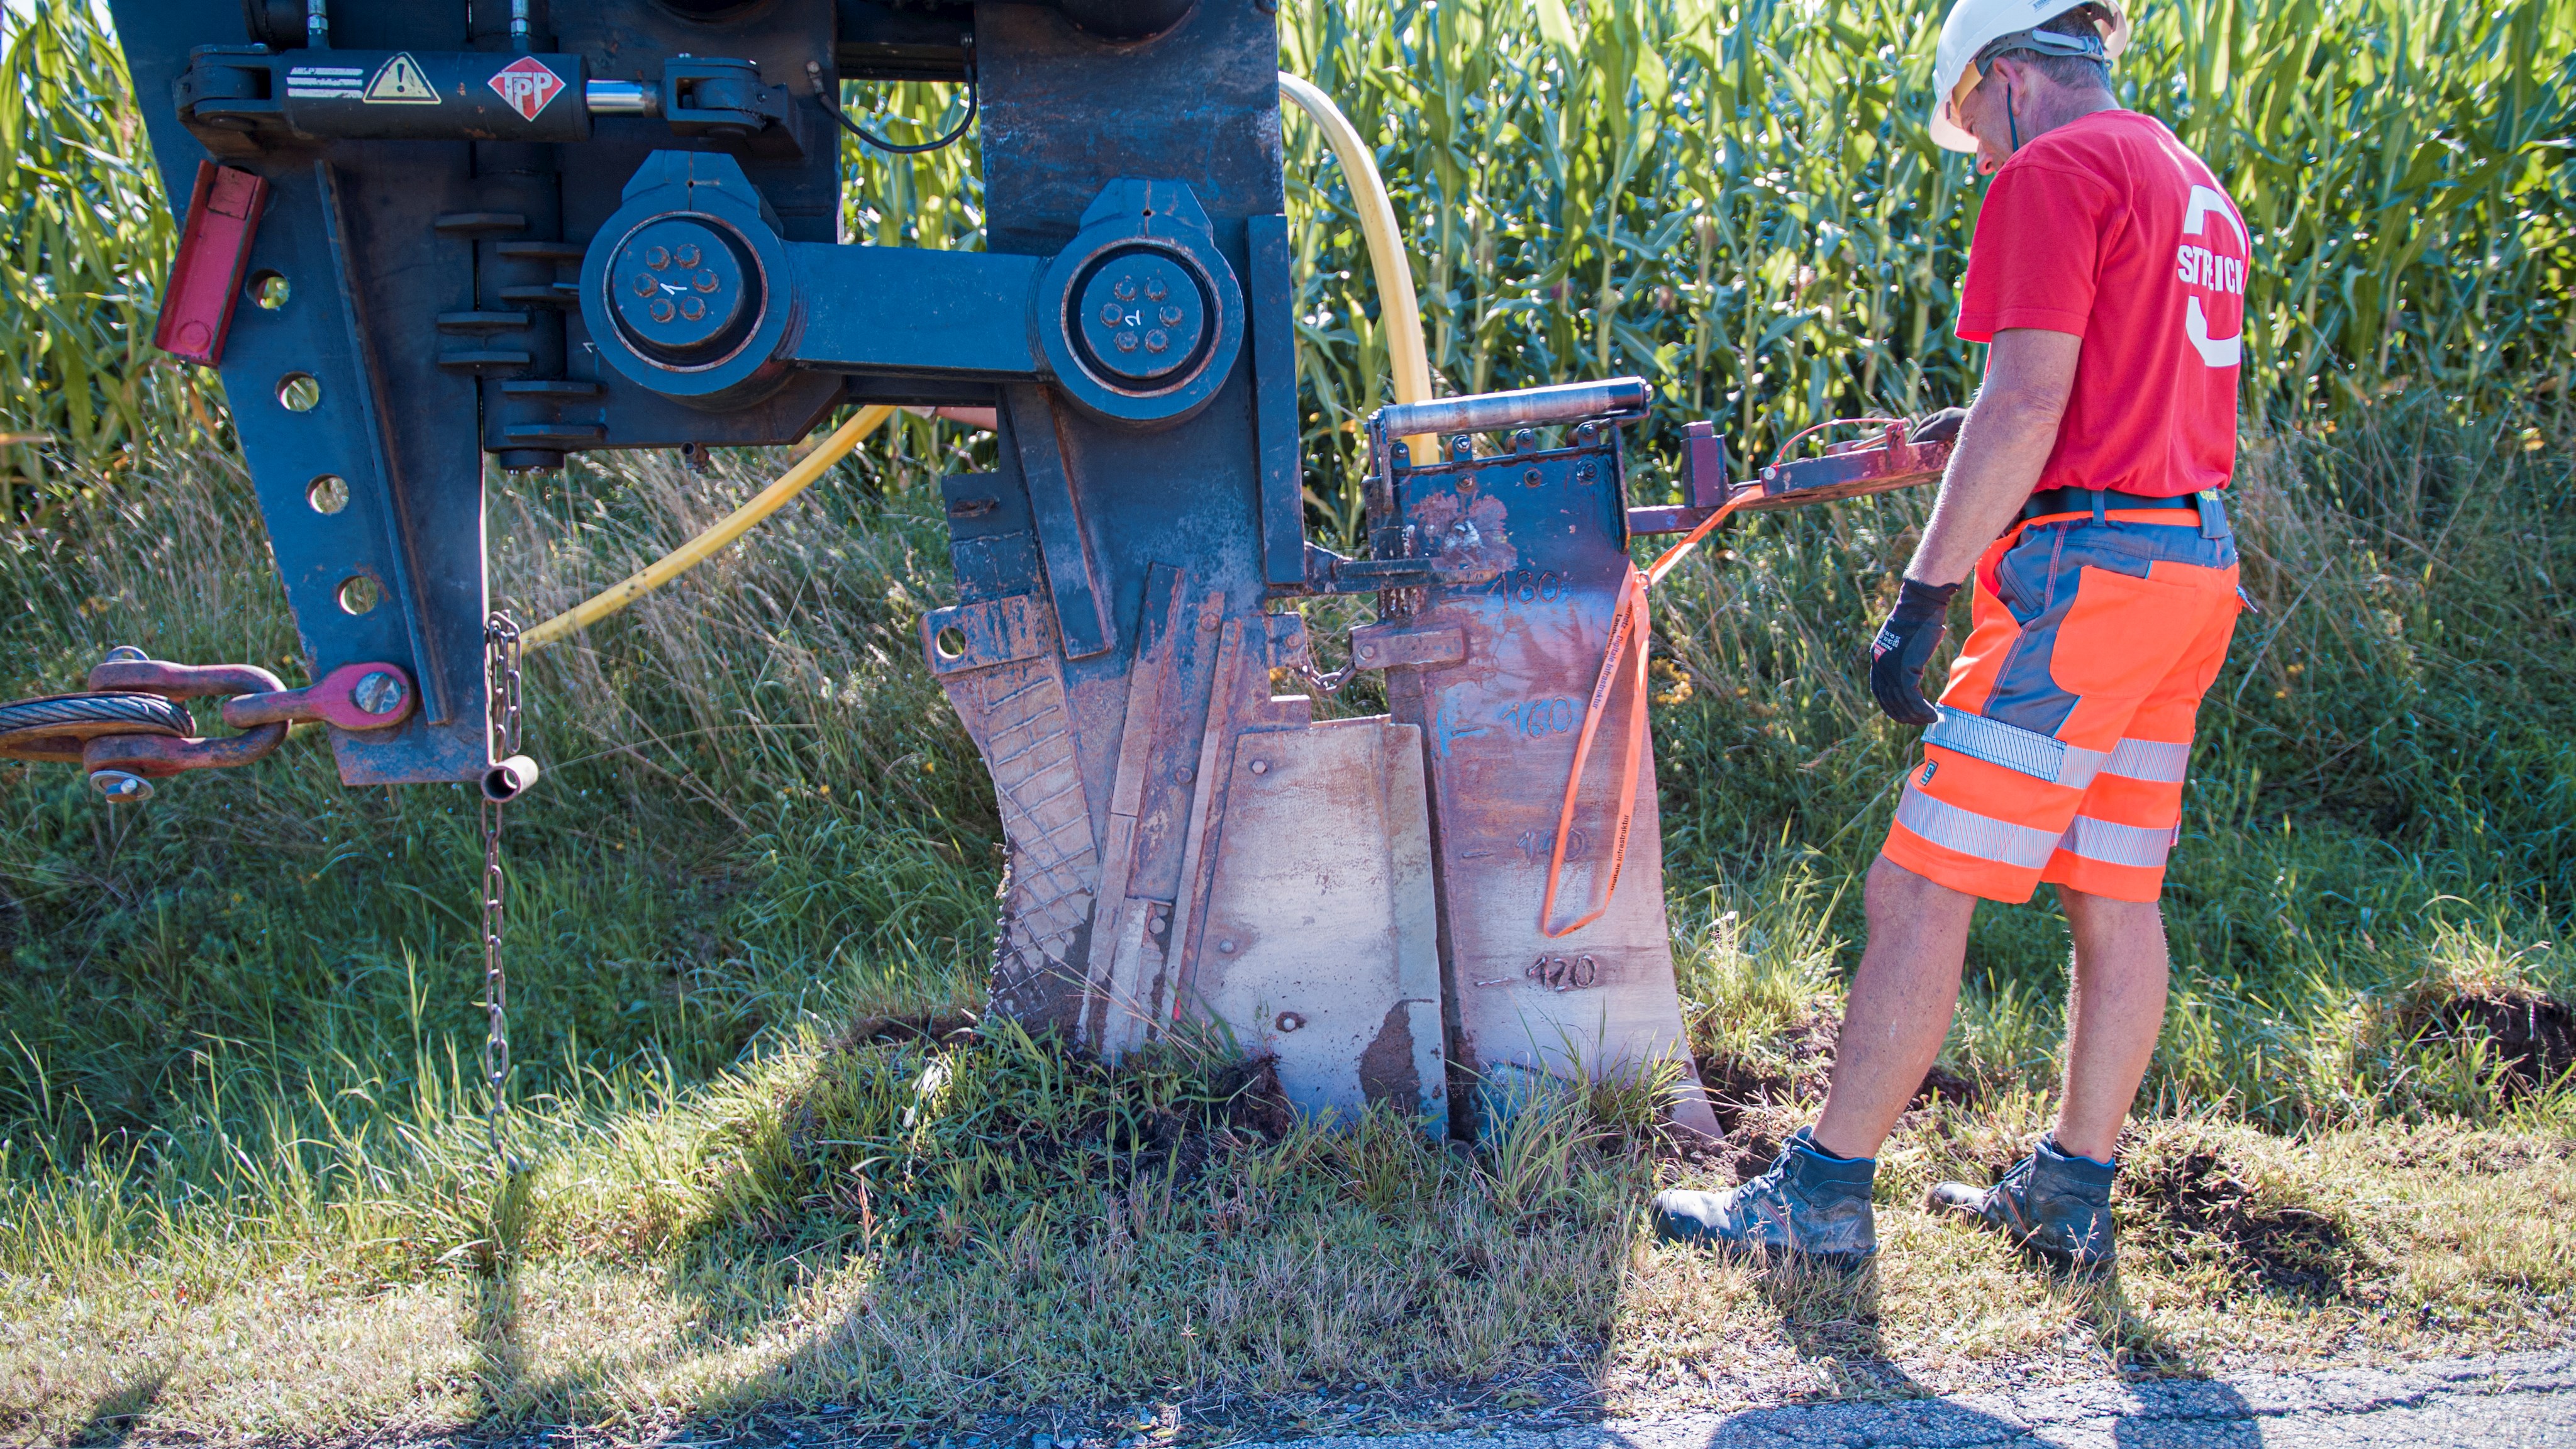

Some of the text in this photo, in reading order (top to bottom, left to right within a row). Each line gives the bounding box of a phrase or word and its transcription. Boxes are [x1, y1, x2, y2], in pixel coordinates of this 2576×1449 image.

[497, 72, 553, 116] TPP
[1124, 309, 1141, 326] 2
[1487, 570, 1561, 610] 180
[1608, 634, 1624, 662] Digitale
[1592, 663, 1614, 709] Infrastruktur
[1501, 695, 1572, 738] 160
[1616, 814, 1630, 862] Infrastruktur
[1525, 955, 1599, 992] 120
